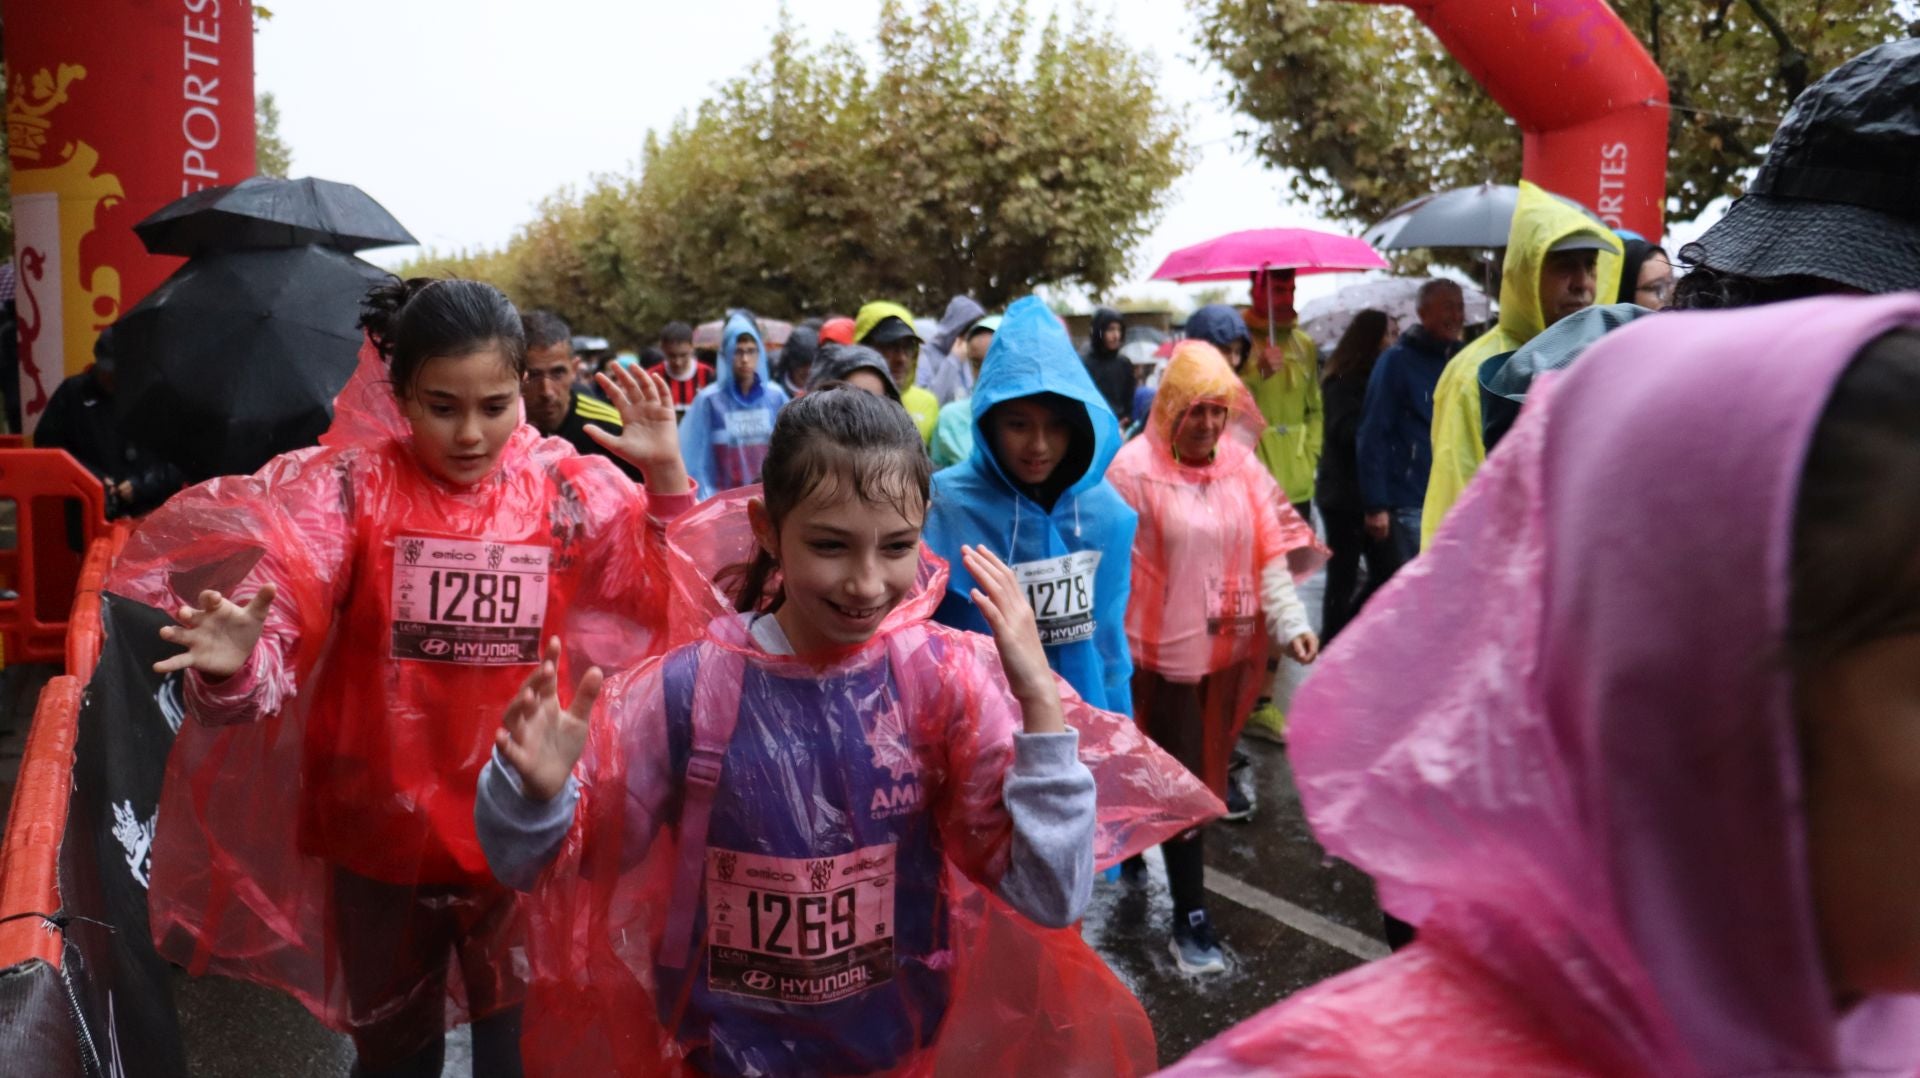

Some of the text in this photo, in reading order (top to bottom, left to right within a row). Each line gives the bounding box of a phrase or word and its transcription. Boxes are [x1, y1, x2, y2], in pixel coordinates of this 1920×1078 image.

[429, 571, 521, 624] 1289
[1027, 575, 1089, 617] 1278
[453, 642, 519, 657] HYUNDAI
[747, 887, 856, 956] 1269
[781, 965, 867, 994] HYUNDAI
